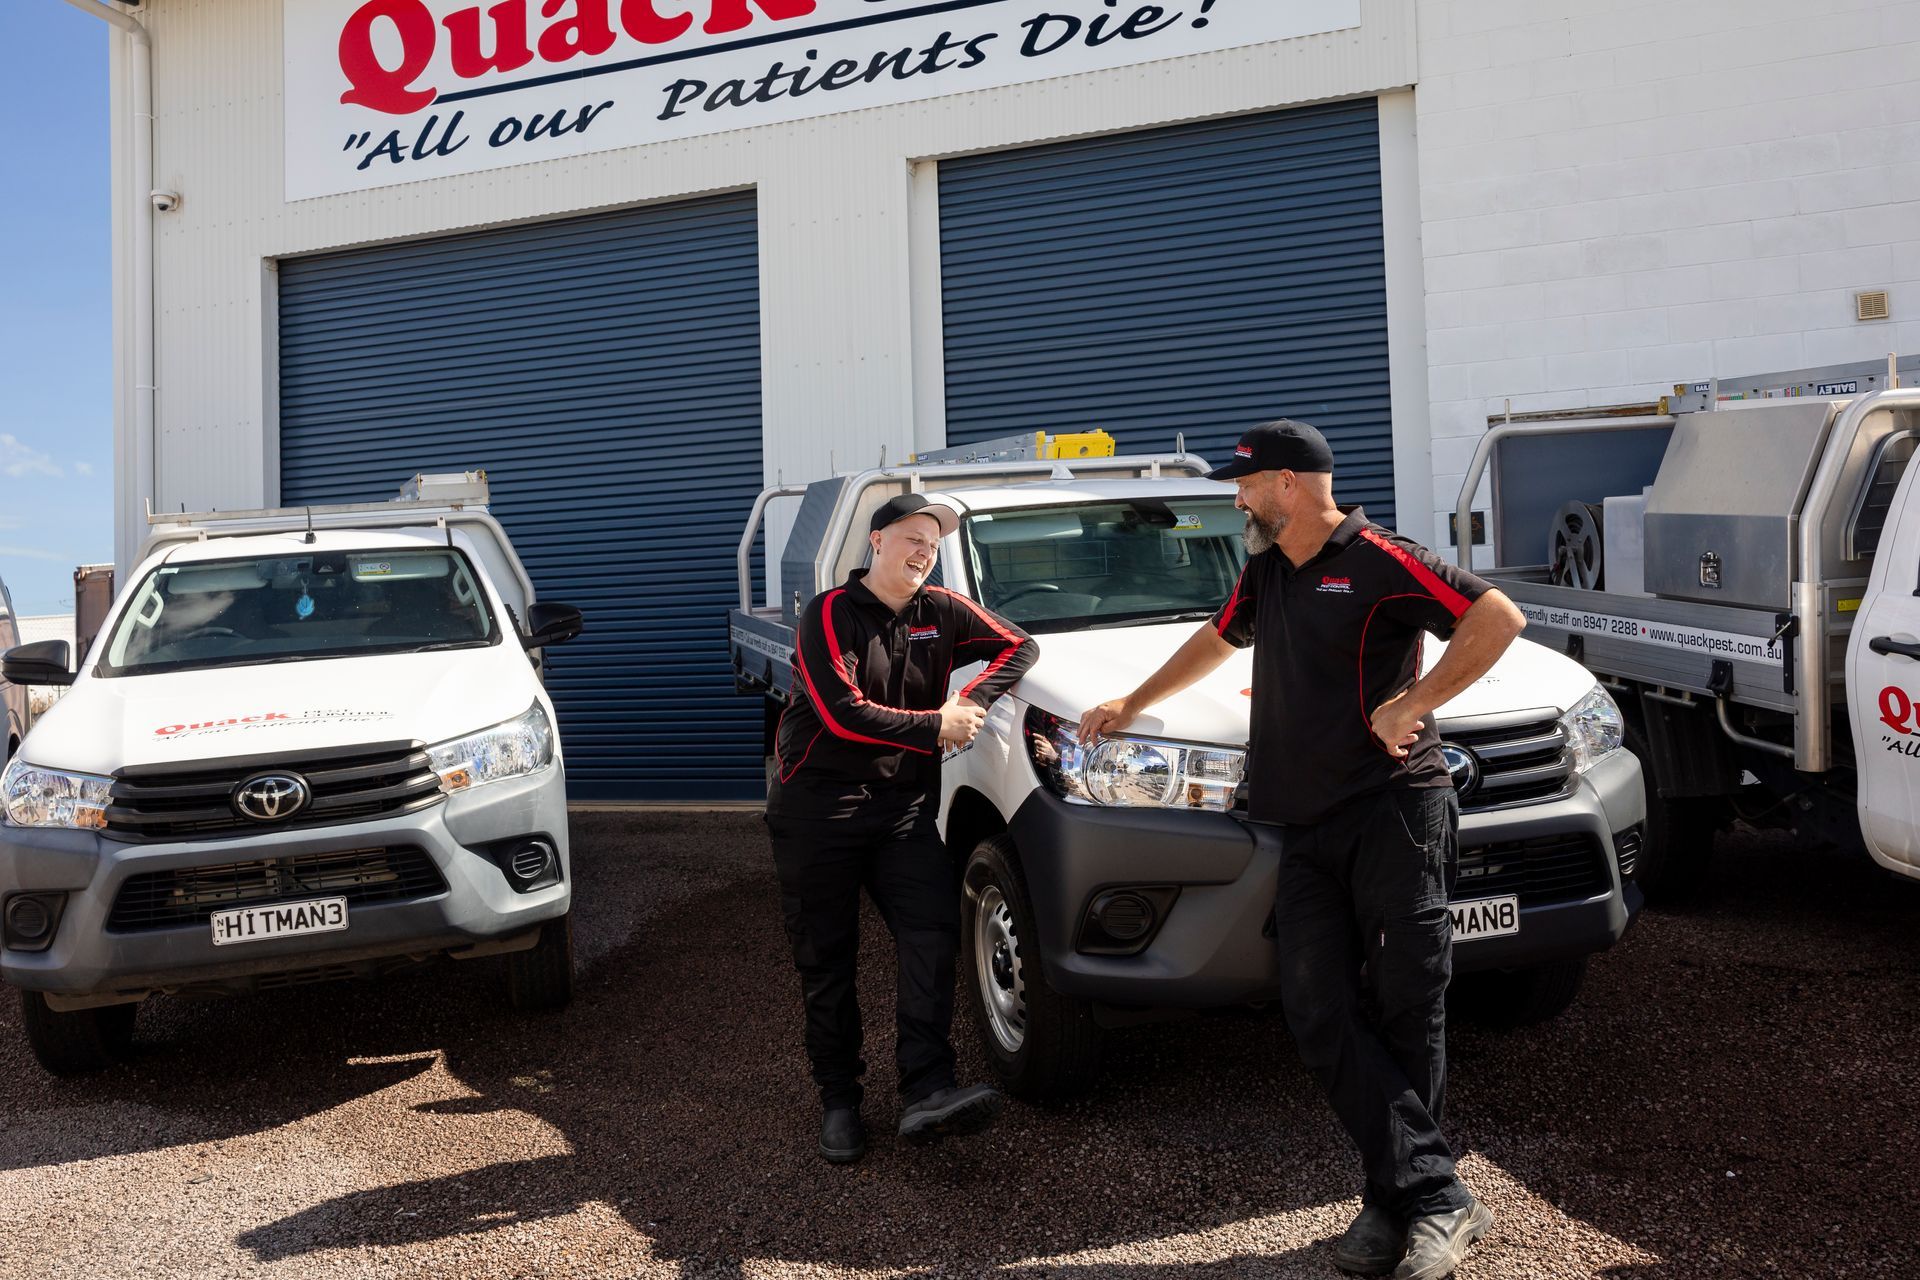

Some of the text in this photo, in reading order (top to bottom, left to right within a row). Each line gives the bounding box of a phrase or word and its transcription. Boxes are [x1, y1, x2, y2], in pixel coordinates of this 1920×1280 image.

[488, 100, 614, 148] our
[656, 30, 998, 121] Patients
[1818, 382, 1857, 395] BAILEY
[1550, 609, 1569, 625] staff
[1571, 616, 1582, 627] on
[1583, 615, 1608, 631] 8947
[1611, 619, 1638, 636] 2288
[1649, 627, 1782, 660] www.quackpest.com.au
[155, 712, 290, 735] Quack
[225, 903, 343, 938] HITMAN3
